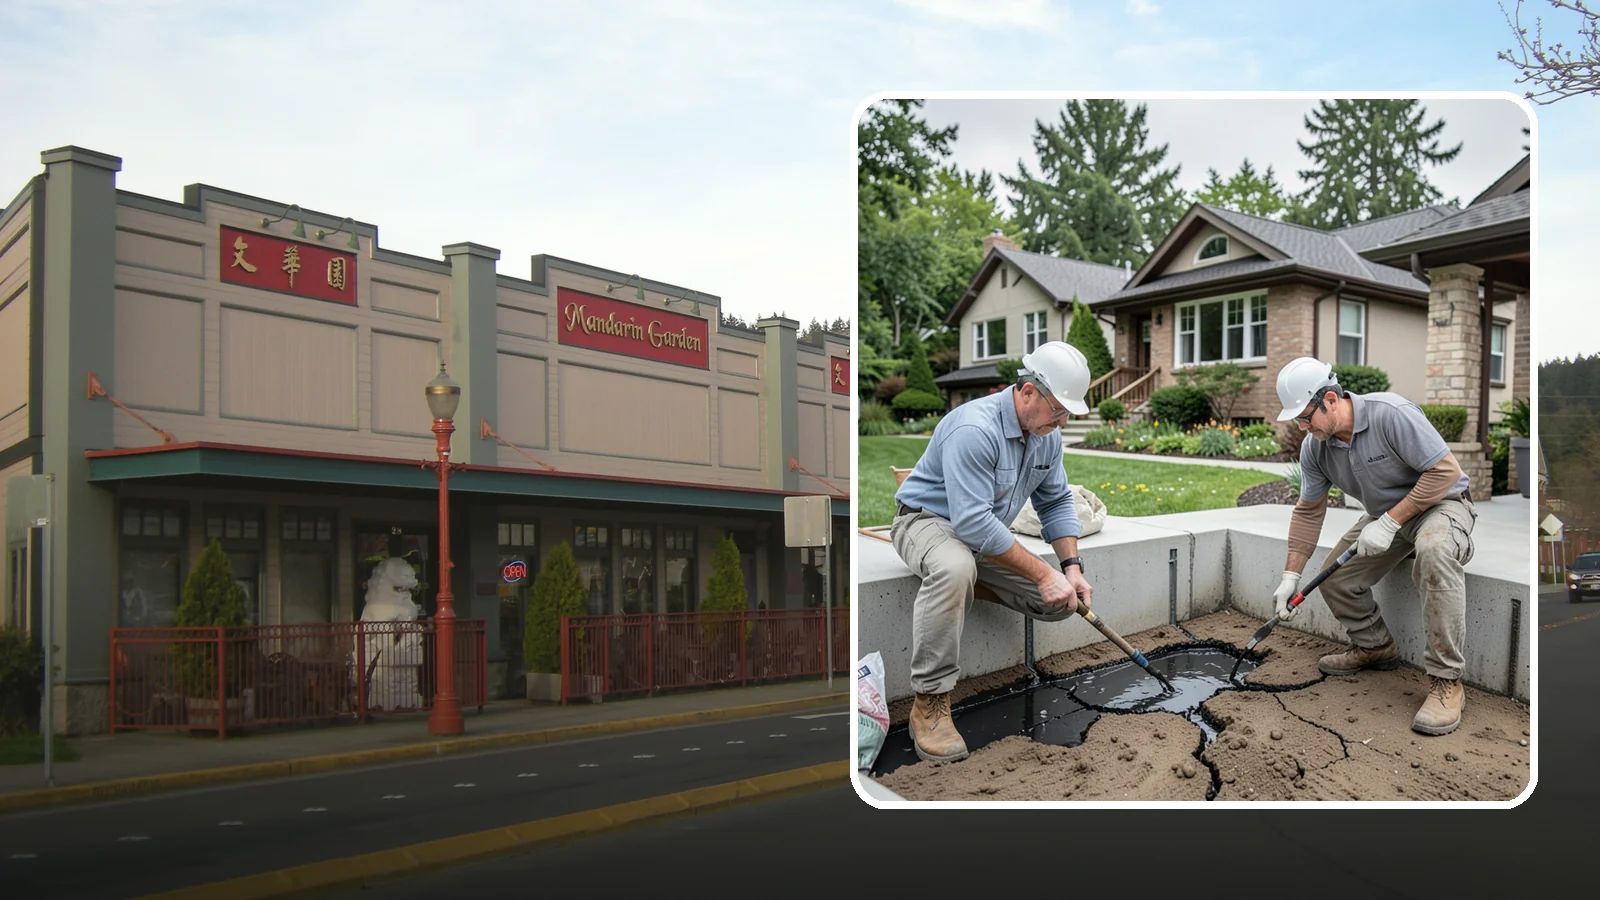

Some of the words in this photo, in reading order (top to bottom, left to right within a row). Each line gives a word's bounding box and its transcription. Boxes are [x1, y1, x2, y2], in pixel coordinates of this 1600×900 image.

[231, 236, 346, 291] 文華園
[564, 302, 644, 341] Mandarin
[648, 320, 701, 352] Garden
[503, 565, 527, 578] OPEN
